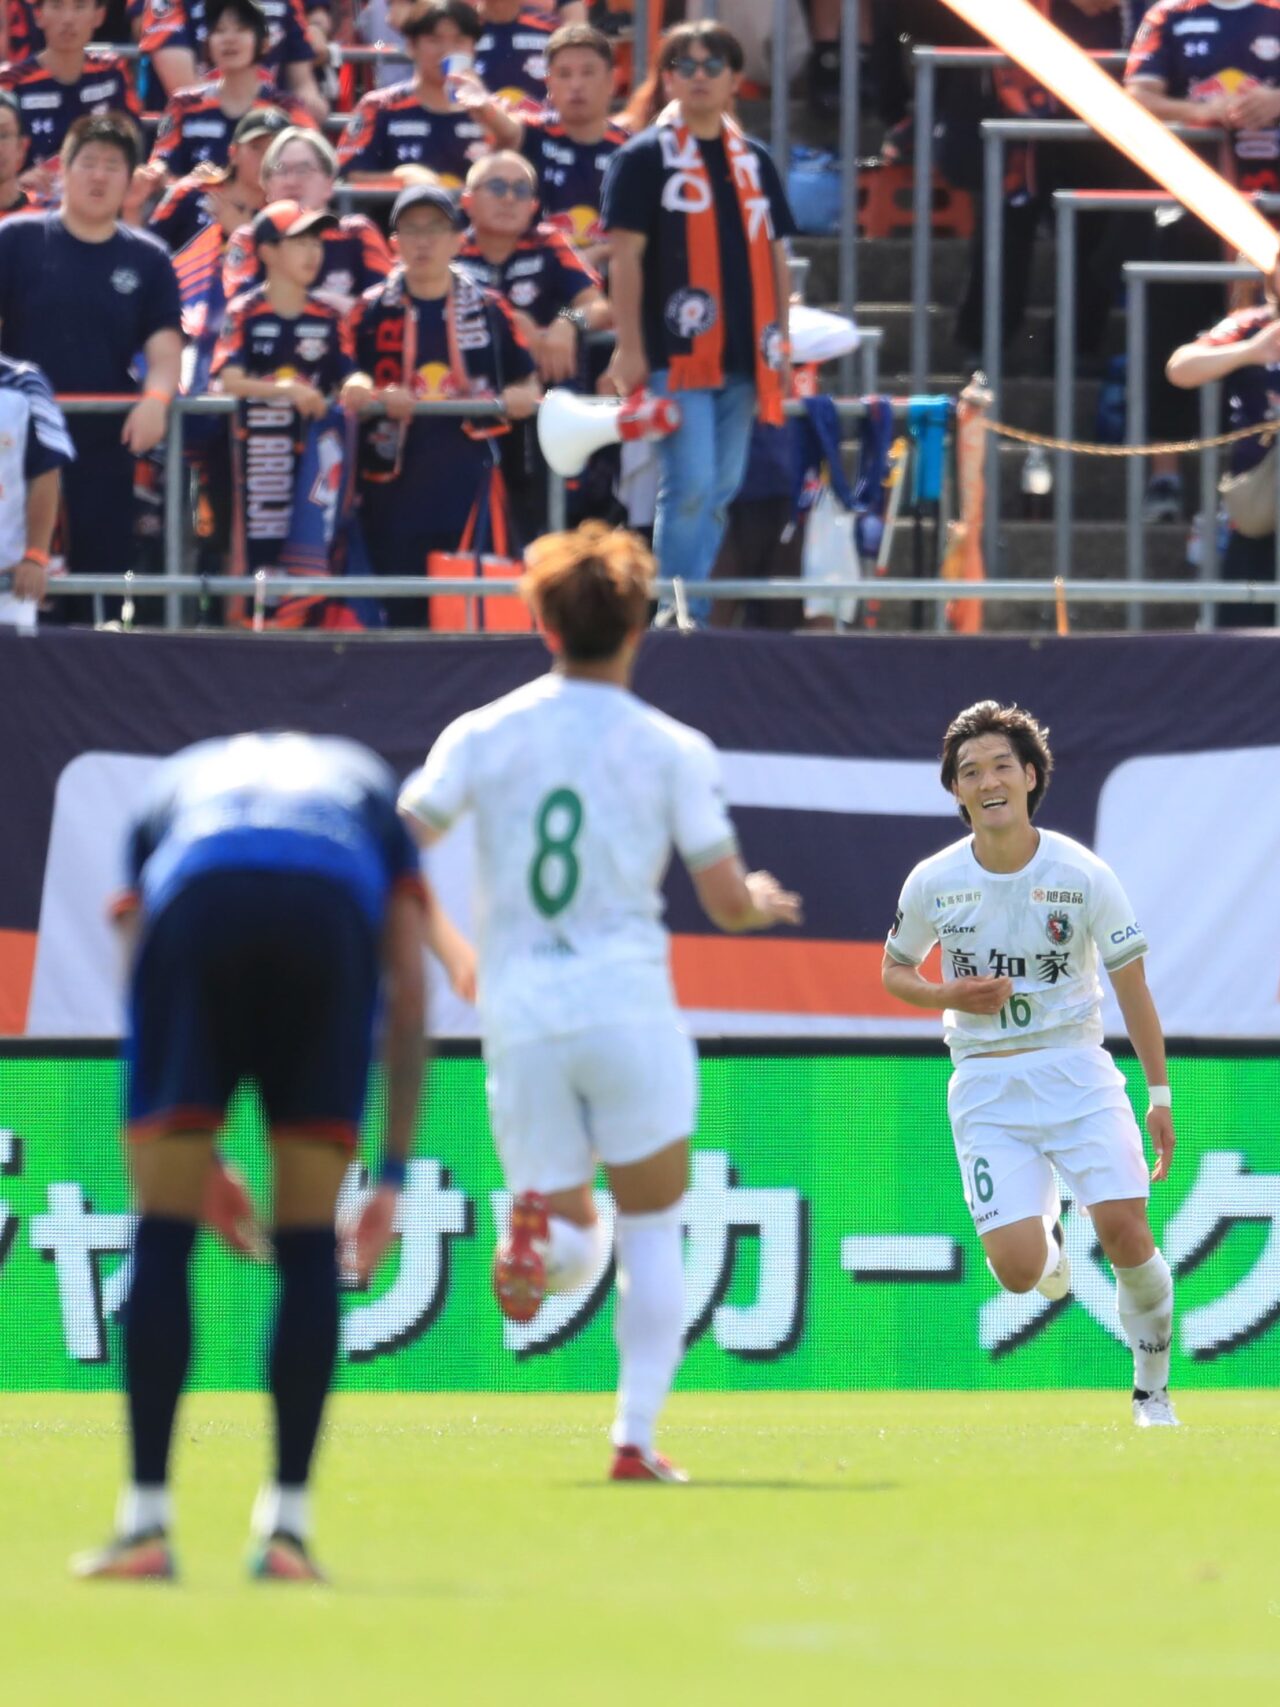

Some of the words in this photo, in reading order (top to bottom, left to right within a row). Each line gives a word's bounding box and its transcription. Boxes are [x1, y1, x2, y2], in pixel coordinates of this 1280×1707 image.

[530, 786, 583, 919] 8
[947, 948, 1073, 985] 高知家
